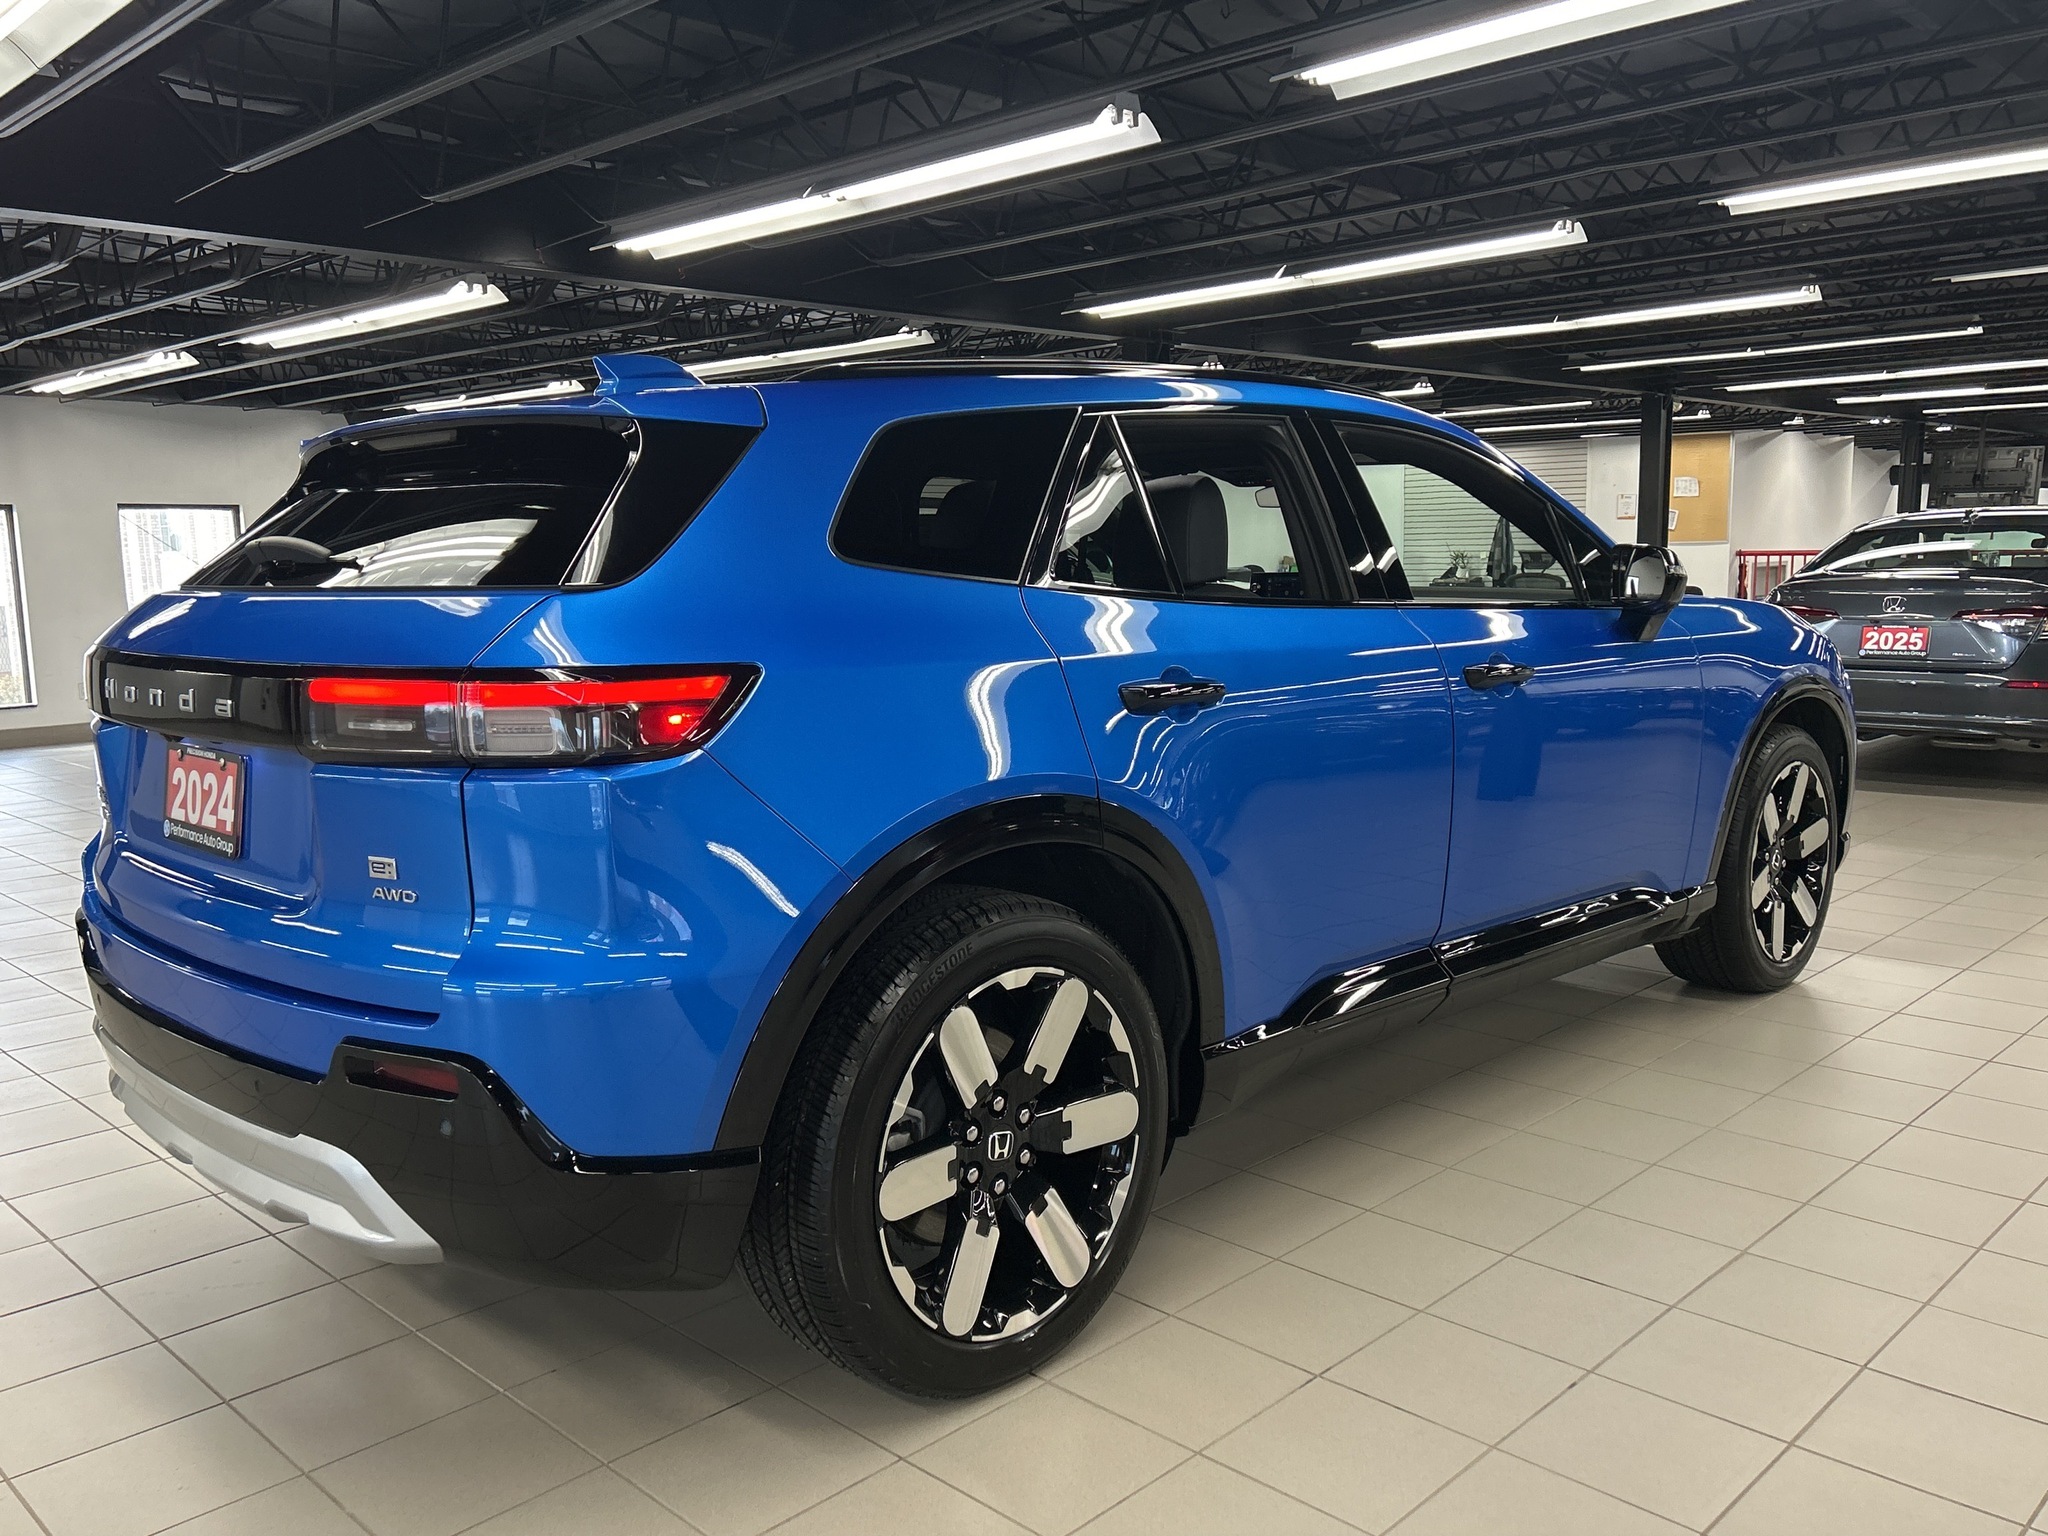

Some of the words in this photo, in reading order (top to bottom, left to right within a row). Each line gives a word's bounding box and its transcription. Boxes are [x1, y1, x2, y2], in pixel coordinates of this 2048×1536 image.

[1863, 632, 1924, 650] 2025
[104, 677, 235, 718] Honda
[170, 767, 235, 832] 2024
[170, 822, 204, 844] Performance
[203, 833, 217, 848] Auto
[216, 837, 234, 857] Group
[372, 886, 417, 904] AWD
